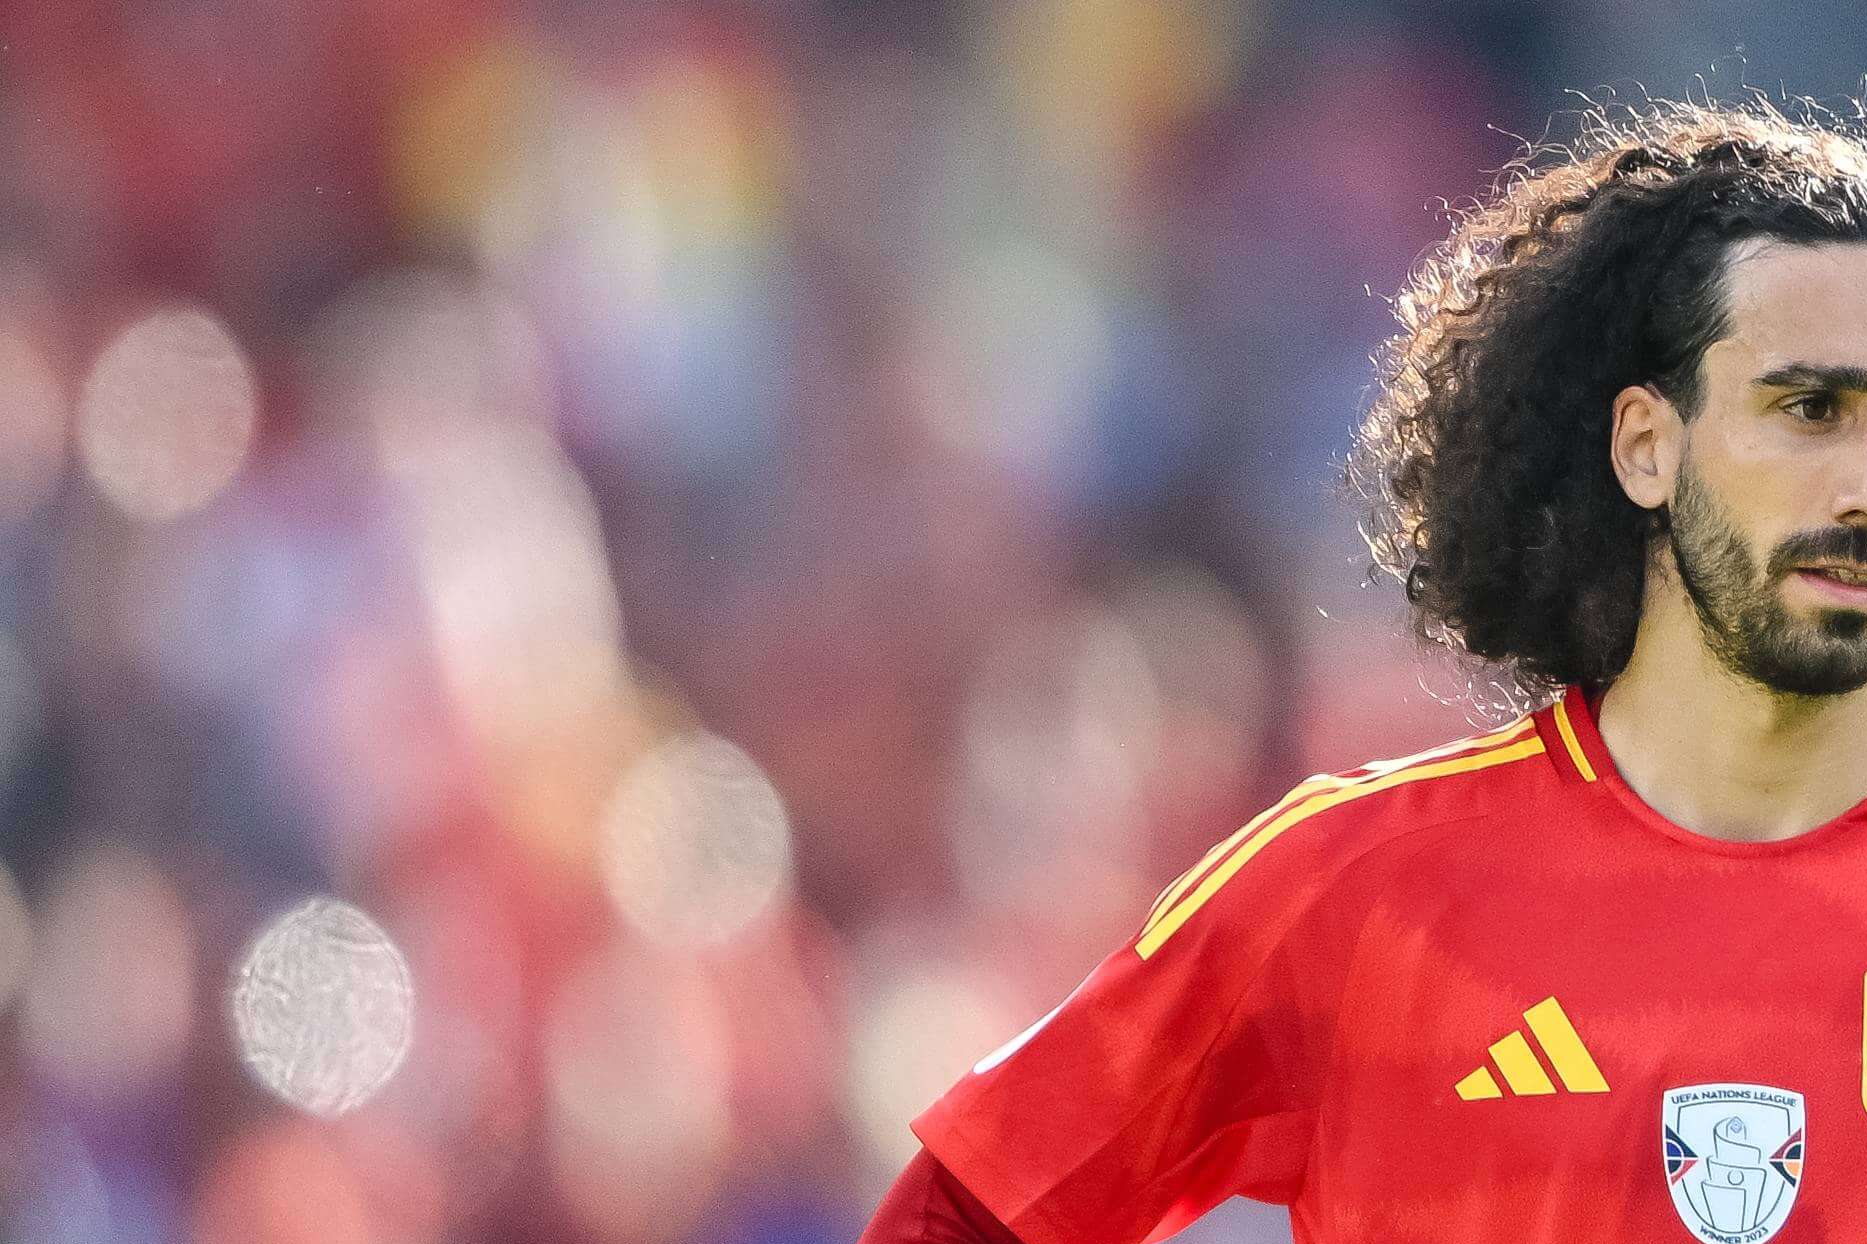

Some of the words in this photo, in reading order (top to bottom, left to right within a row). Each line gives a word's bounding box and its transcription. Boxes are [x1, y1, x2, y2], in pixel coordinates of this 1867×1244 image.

[1671, 1093, 1699, 1104] UEFA
[1701, 1089, 1751, 1100] NATIONS
[1754, 1091, 1797, 1107] LEAGUE
[1700, 1224, 1742, 1244] WINNER
[1743, 1226, 1769, 1243] 2023
